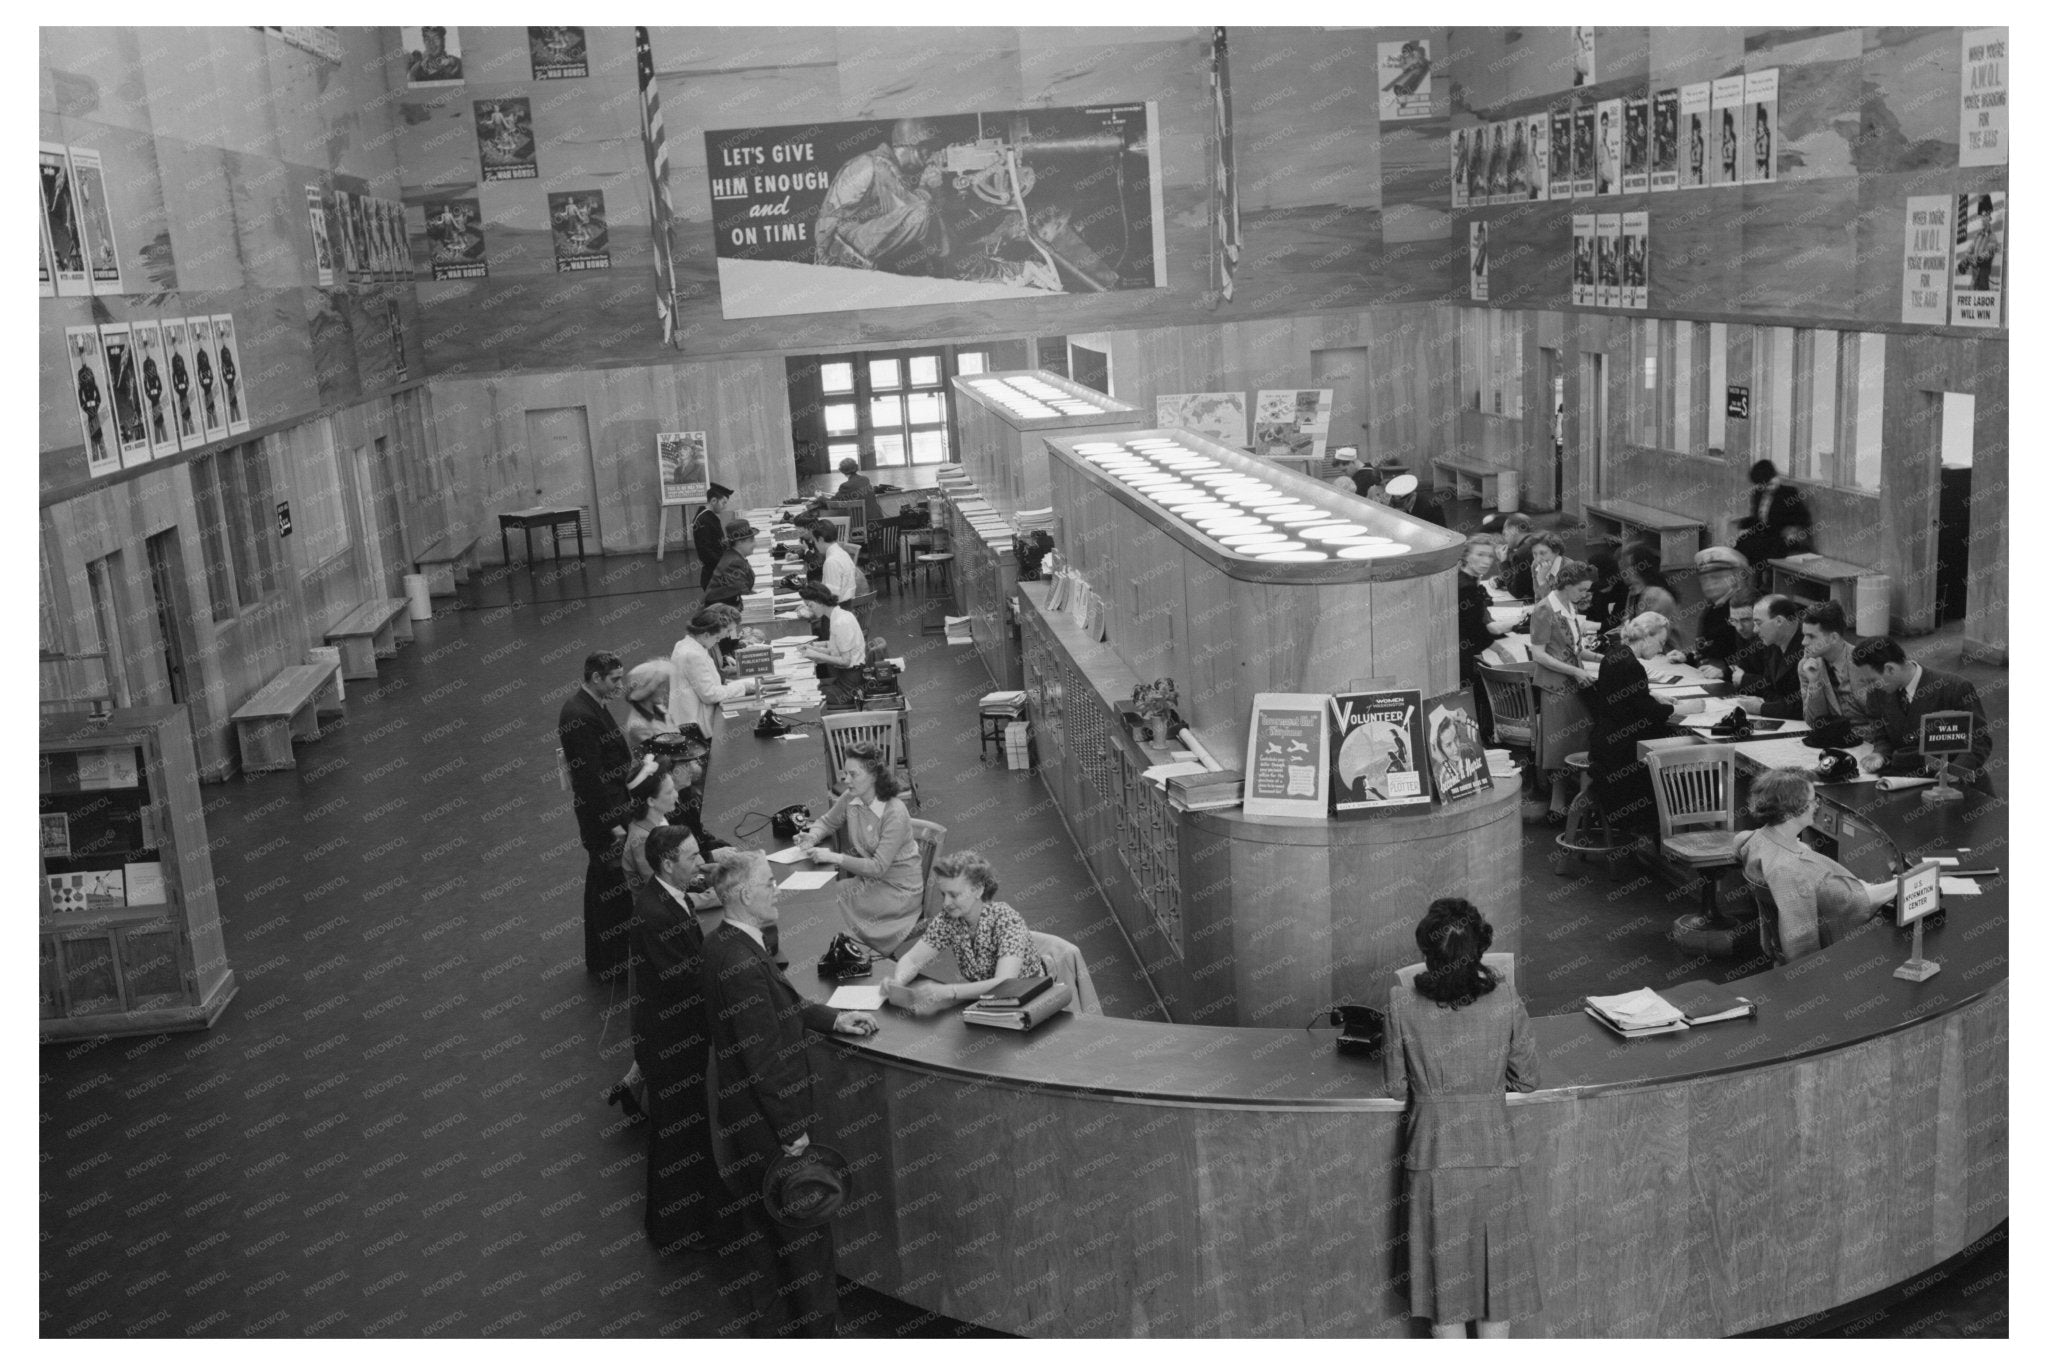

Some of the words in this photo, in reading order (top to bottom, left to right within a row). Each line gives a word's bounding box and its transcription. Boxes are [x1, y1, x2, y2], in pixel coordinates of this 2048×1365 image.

[1978, 111, 1989, 128] FOR
[723, 147, 765, 166] LET'S
[772, 143, 814, 163] GIVE
[713, 176, 748, 197] HIM
[754, 171, 829, 194] ENOUGH
[749, 195, 790, 218] and
[731, 227, 757, 246] ON
[764, 223, 807, 243] TIME
[571, 261, 585, 270] WAR
[586, 259, 609, 269] BONDS
[1920, 273, 1931, 288] FOR
[1957, 295, 1972, 307] FREE
[1972, 295, 1995, 307] LABOR
[1960, 309, 1976, 319] WILL
[1976, 309, 1991, 320] WIN
[1741, 396, 1748, 416] S
[1938, 724, 1958, 732] WAR
[1928, 733, 1966, 742] HOUSING
[1389, 781, 1418, 793] PLOTTER
[1908, 897, 1928, 911] CENTER
